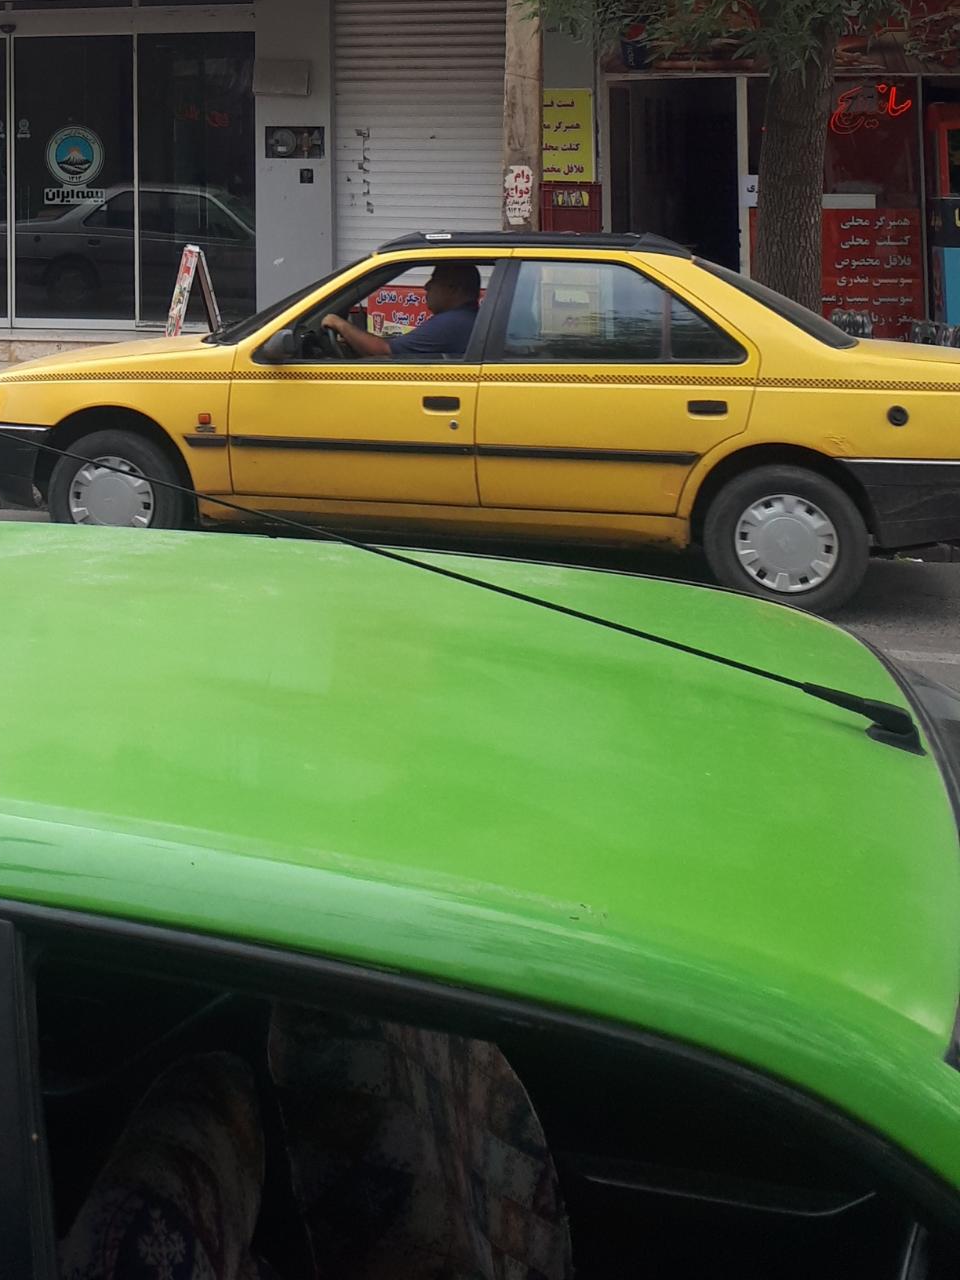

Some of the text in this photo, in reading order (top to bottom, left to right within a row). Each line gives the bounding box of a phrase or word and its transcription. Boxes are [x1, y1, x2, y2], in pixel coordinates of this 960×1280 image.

[542, 142, 559, 152] محل
[514, 169, 530, 183] وام
[543, 164, 585, 176] فلافل مخص
[45, 189, 104, 203] بیمه ایران
[840, 216, 870, 229] محلی
[840, 236, 870, 248] محلی
[834, 255, 912, 268] فلافل مخصوص
[836, 275, 869, 287] بندری
[375, 290, 397, 305] فلافل
